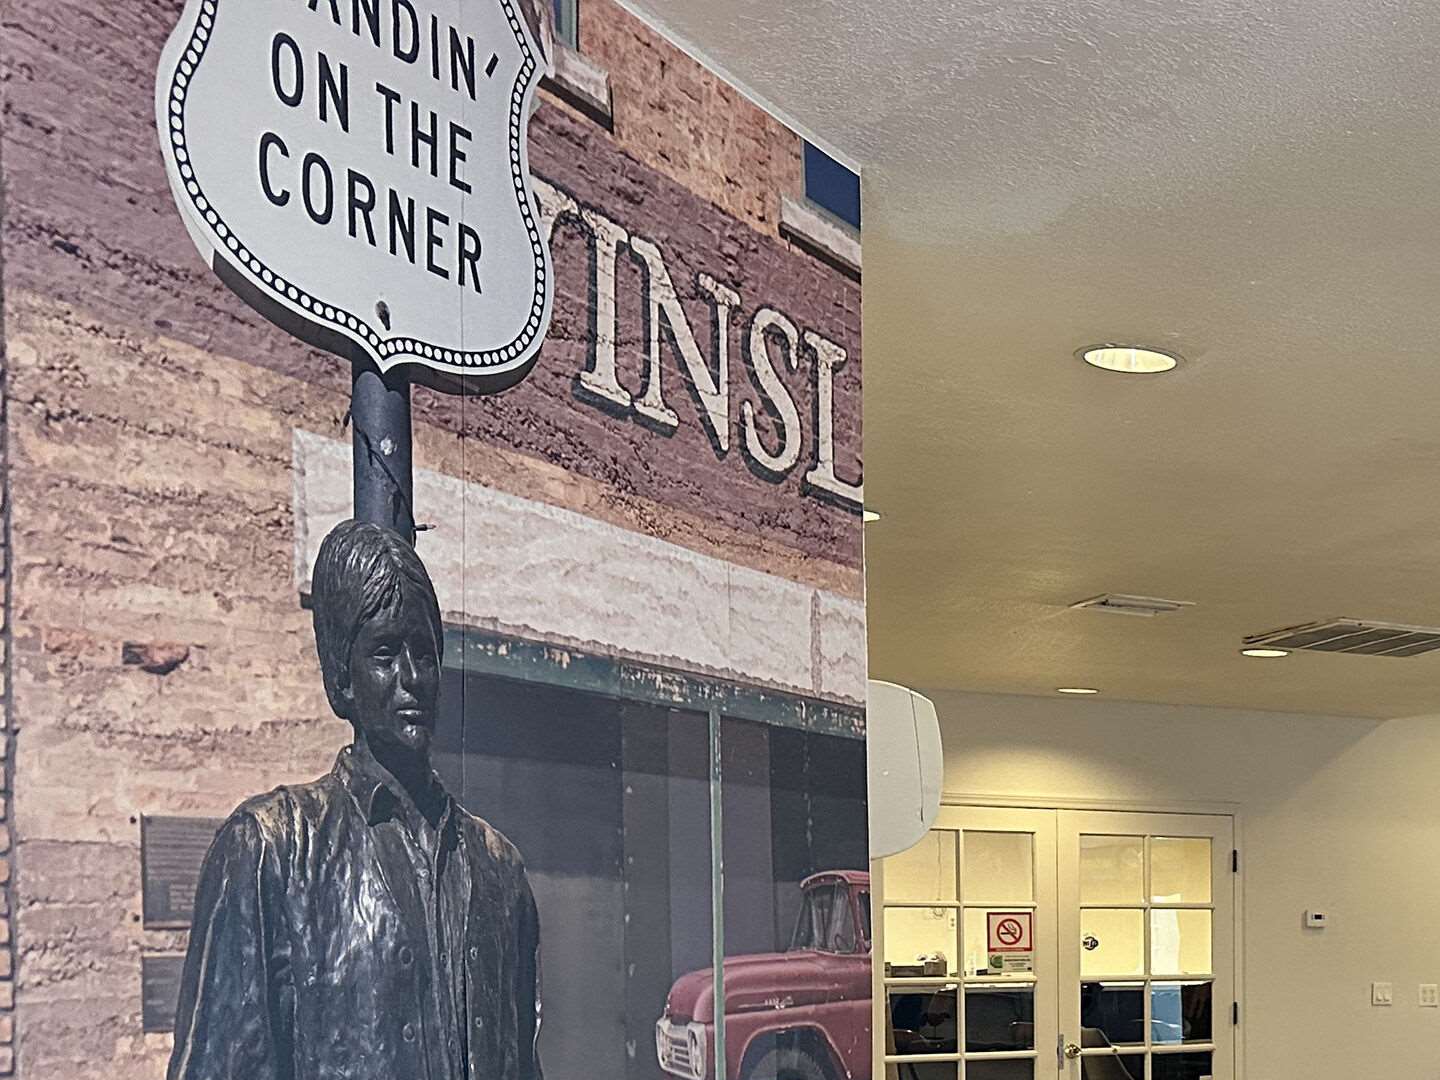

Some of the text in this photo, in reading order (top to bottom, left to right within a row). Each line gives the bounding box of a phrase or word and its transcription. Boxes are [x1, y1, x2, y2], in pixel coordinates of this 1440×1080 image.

[271, 32, 473, 195] ON THE
[308, 0, 499, 101] NDIN'
[258, 131, 482, 294] CORNER
